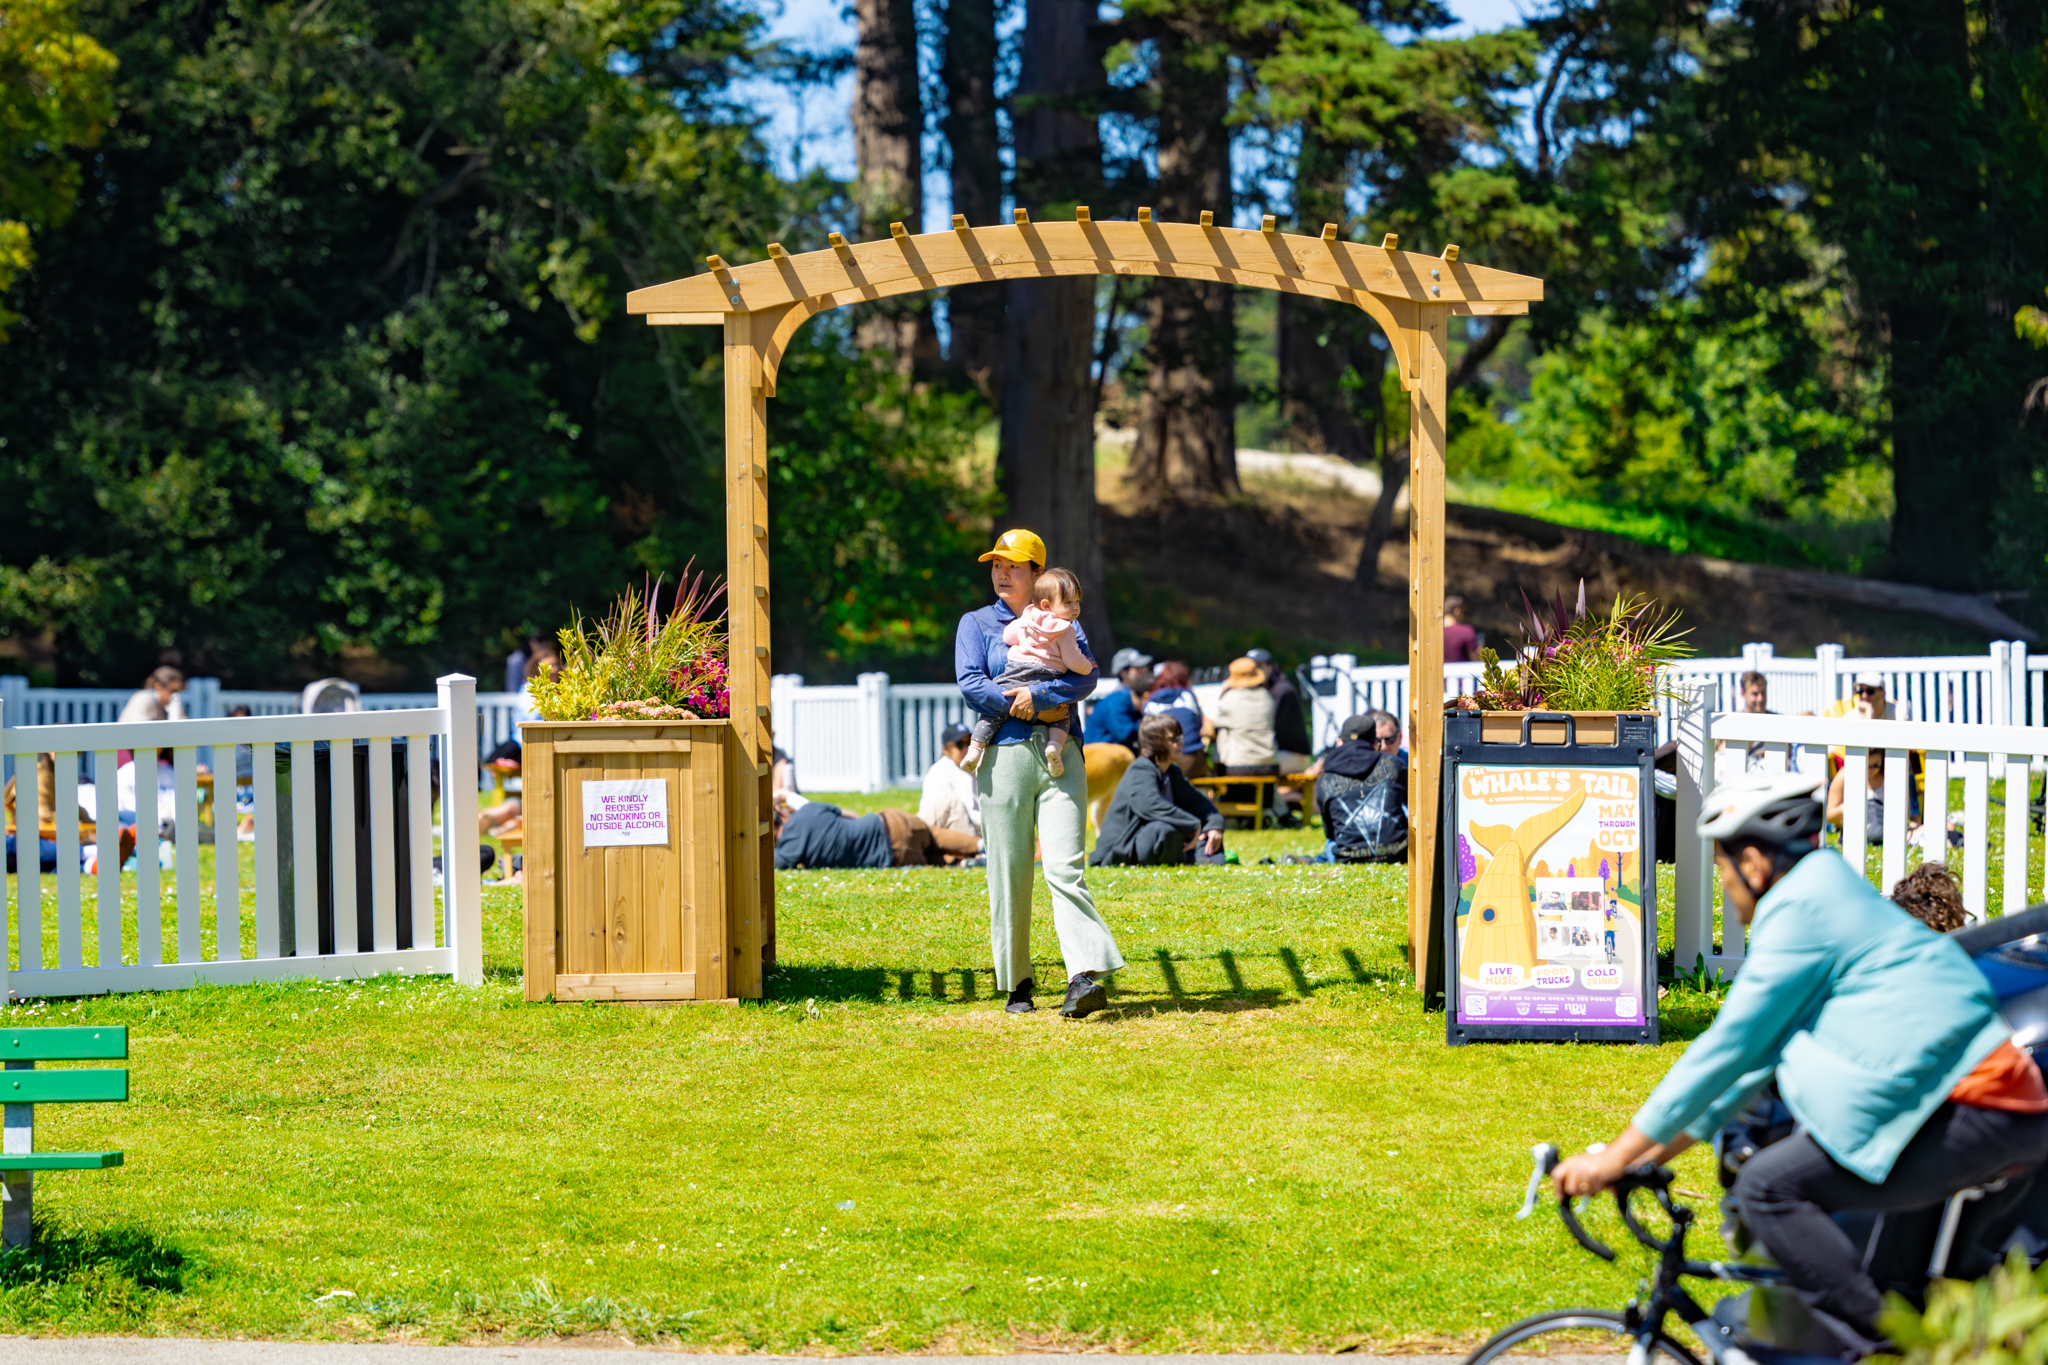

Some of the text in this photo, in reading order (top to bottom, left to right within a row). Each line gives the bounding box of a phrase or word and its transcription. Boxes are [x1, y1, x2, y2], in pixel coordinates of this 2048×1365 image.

[1468, 767, 1486, 776] THE
[1468, 770, 1570, 796] WHALE'S
[618, 794, 648, 802] KINDLY
[606, 804, 645, 812] REQUEST
[1598, 804, 1635, 818] MAY
[606, 812, 646, 821] SMOKING
[586, 820, 666, 830] OUTSIDE ALCOHOL
[1600, 830, 1636, 846] OCT
[1537, 968, 1568, 976] FOOD
[1587, 968, 1617, 977] COLD
[1536, 976, 1570, 985] TRUCKS
